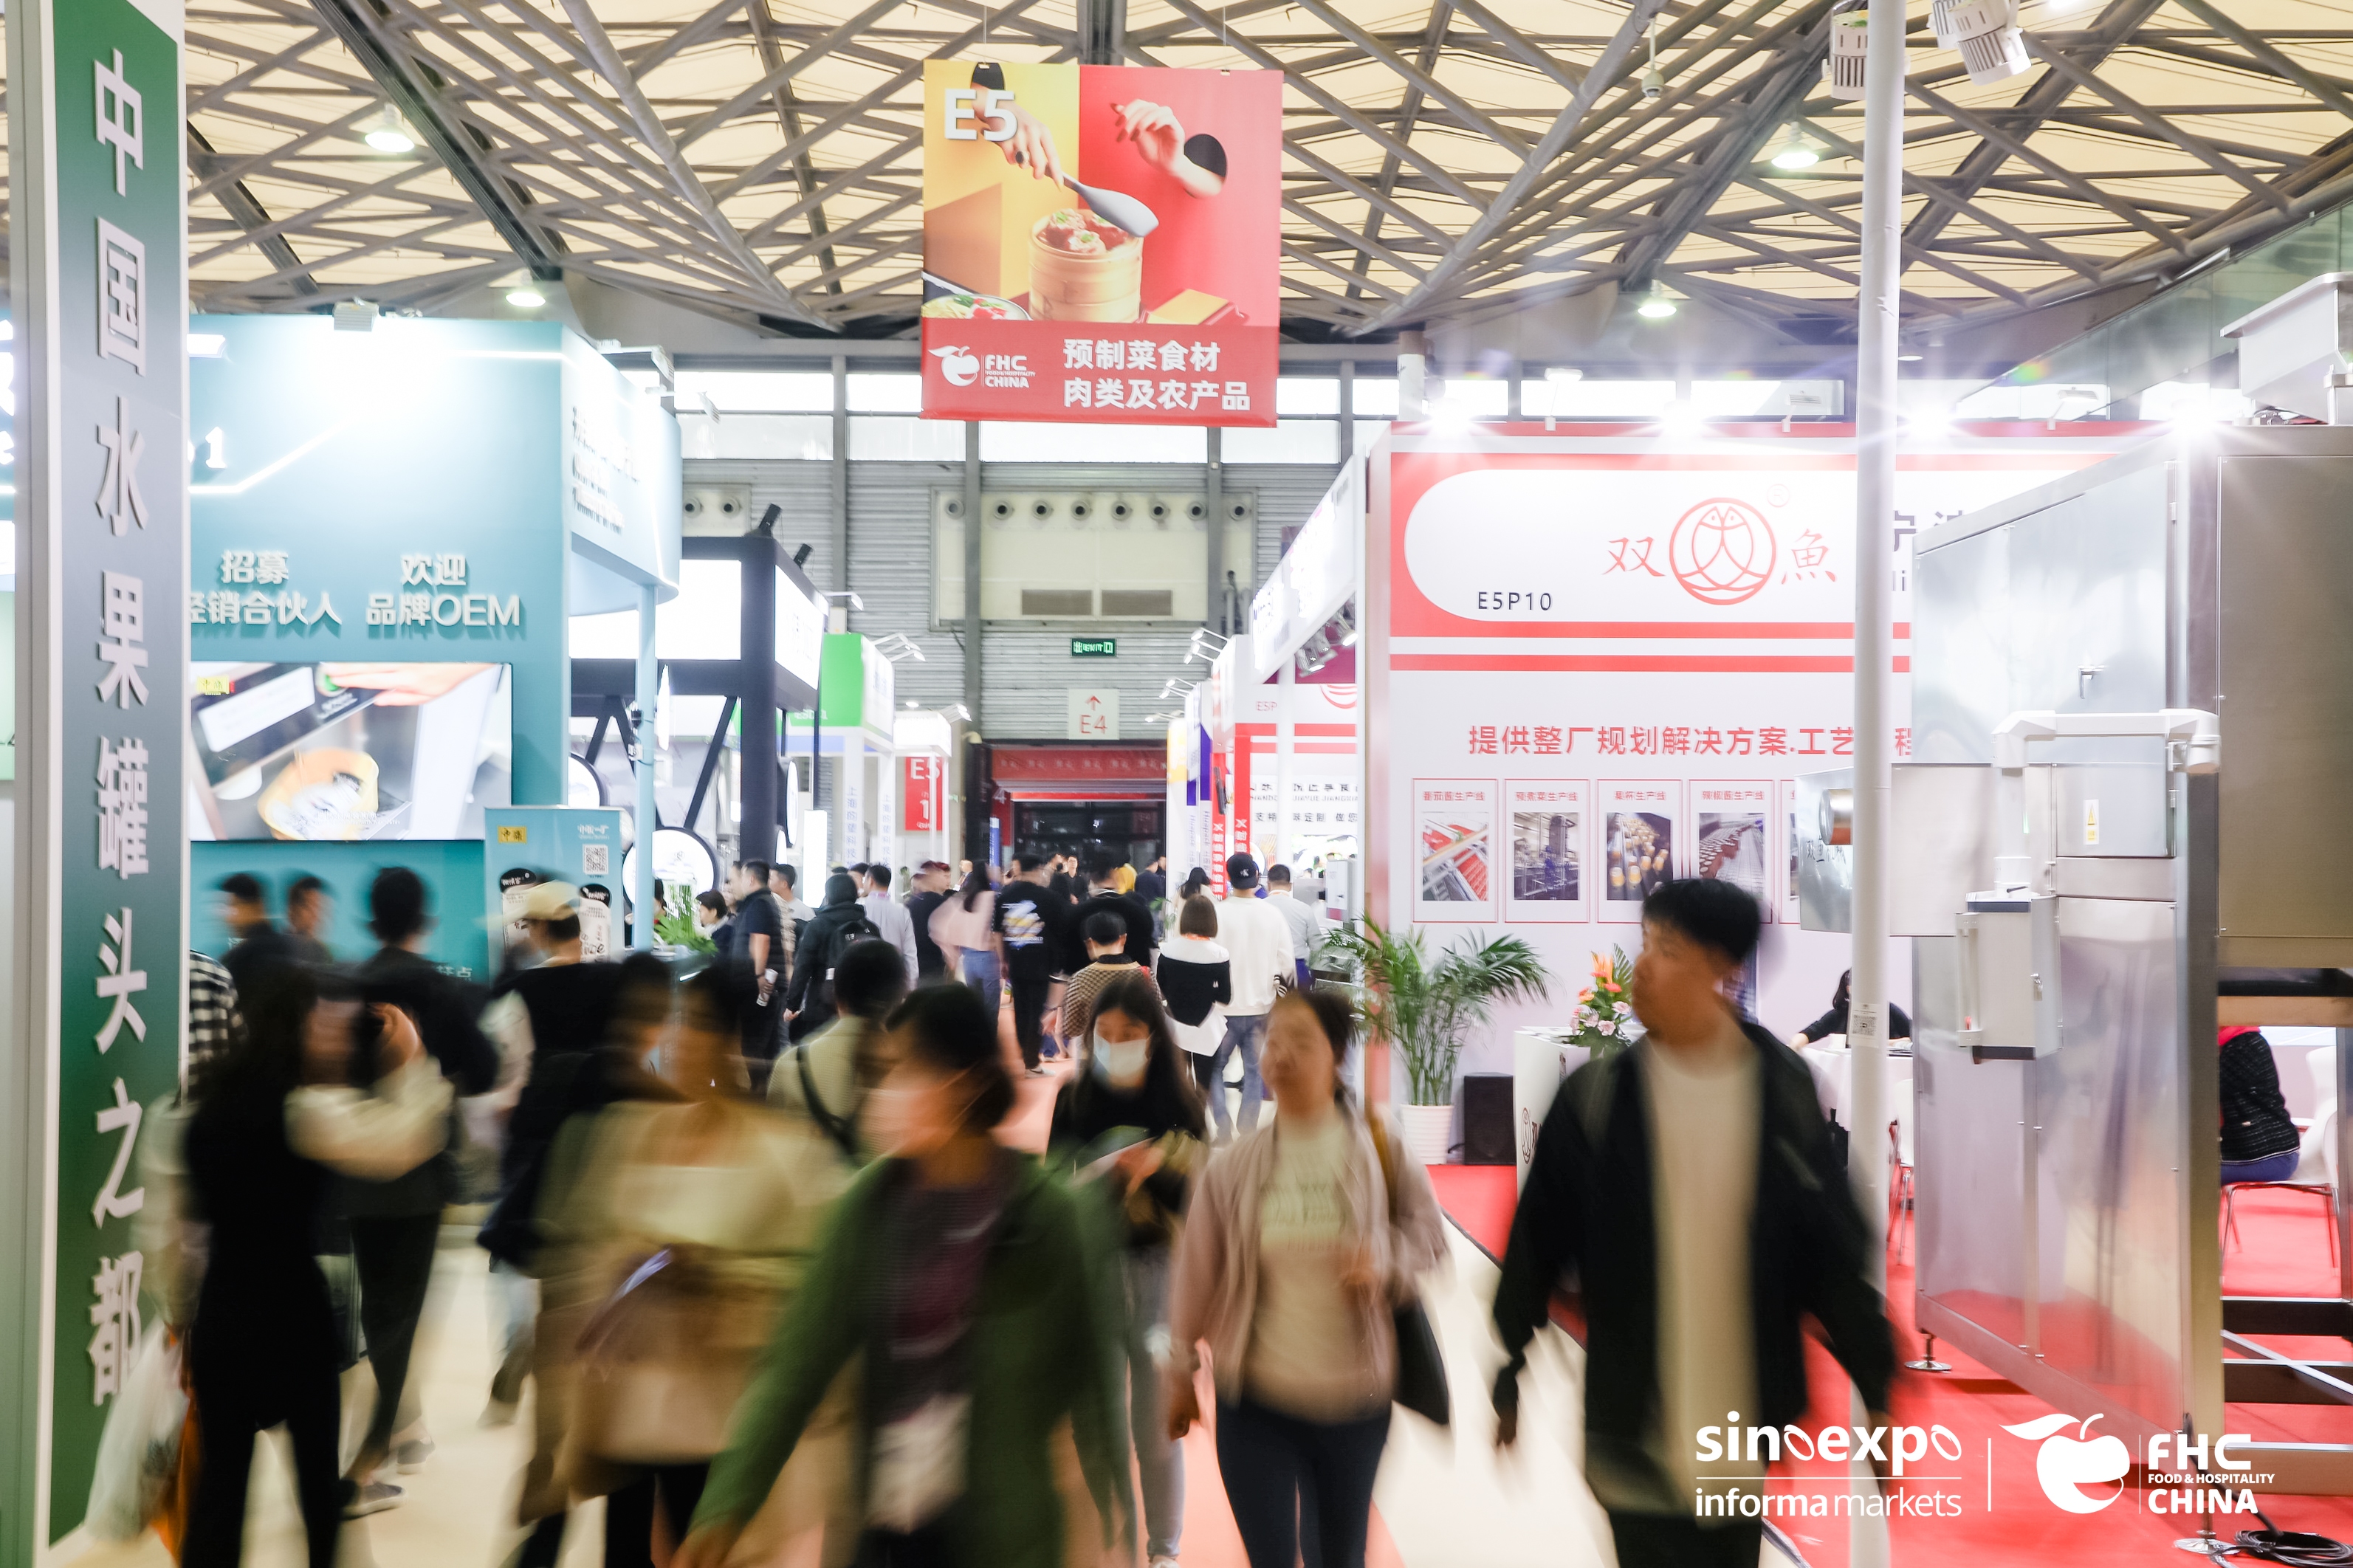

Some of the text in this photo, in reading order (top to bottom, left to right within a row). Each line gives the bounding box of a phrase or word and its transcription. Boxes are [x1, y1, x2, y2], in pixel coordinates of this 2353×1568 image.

[944, 89, 1018, 141] E5
[985, 354, 1027, 371] FHC
[1063, 339, 1220, 371] 预制菜食材
[985, 376, 1029, 388] CHINA
[1064, 379, 1251, 410] 肉类及农产品
[221, 550, 289, 585] 招募
[401, 553, 467, 586] 欢迎
[1602, 528, 1837, 585] 双 魚
[366, 593, 520, 627] 品牌OEM
[1477, 592, 1551, 611] E5P10
[87, 48, 150, 1406] 中国水果罐头之都
[1080, 715, 1107, 734] E4
[1469, 726, 1912, 756] 提供整厂规划解决方案.工艺程
